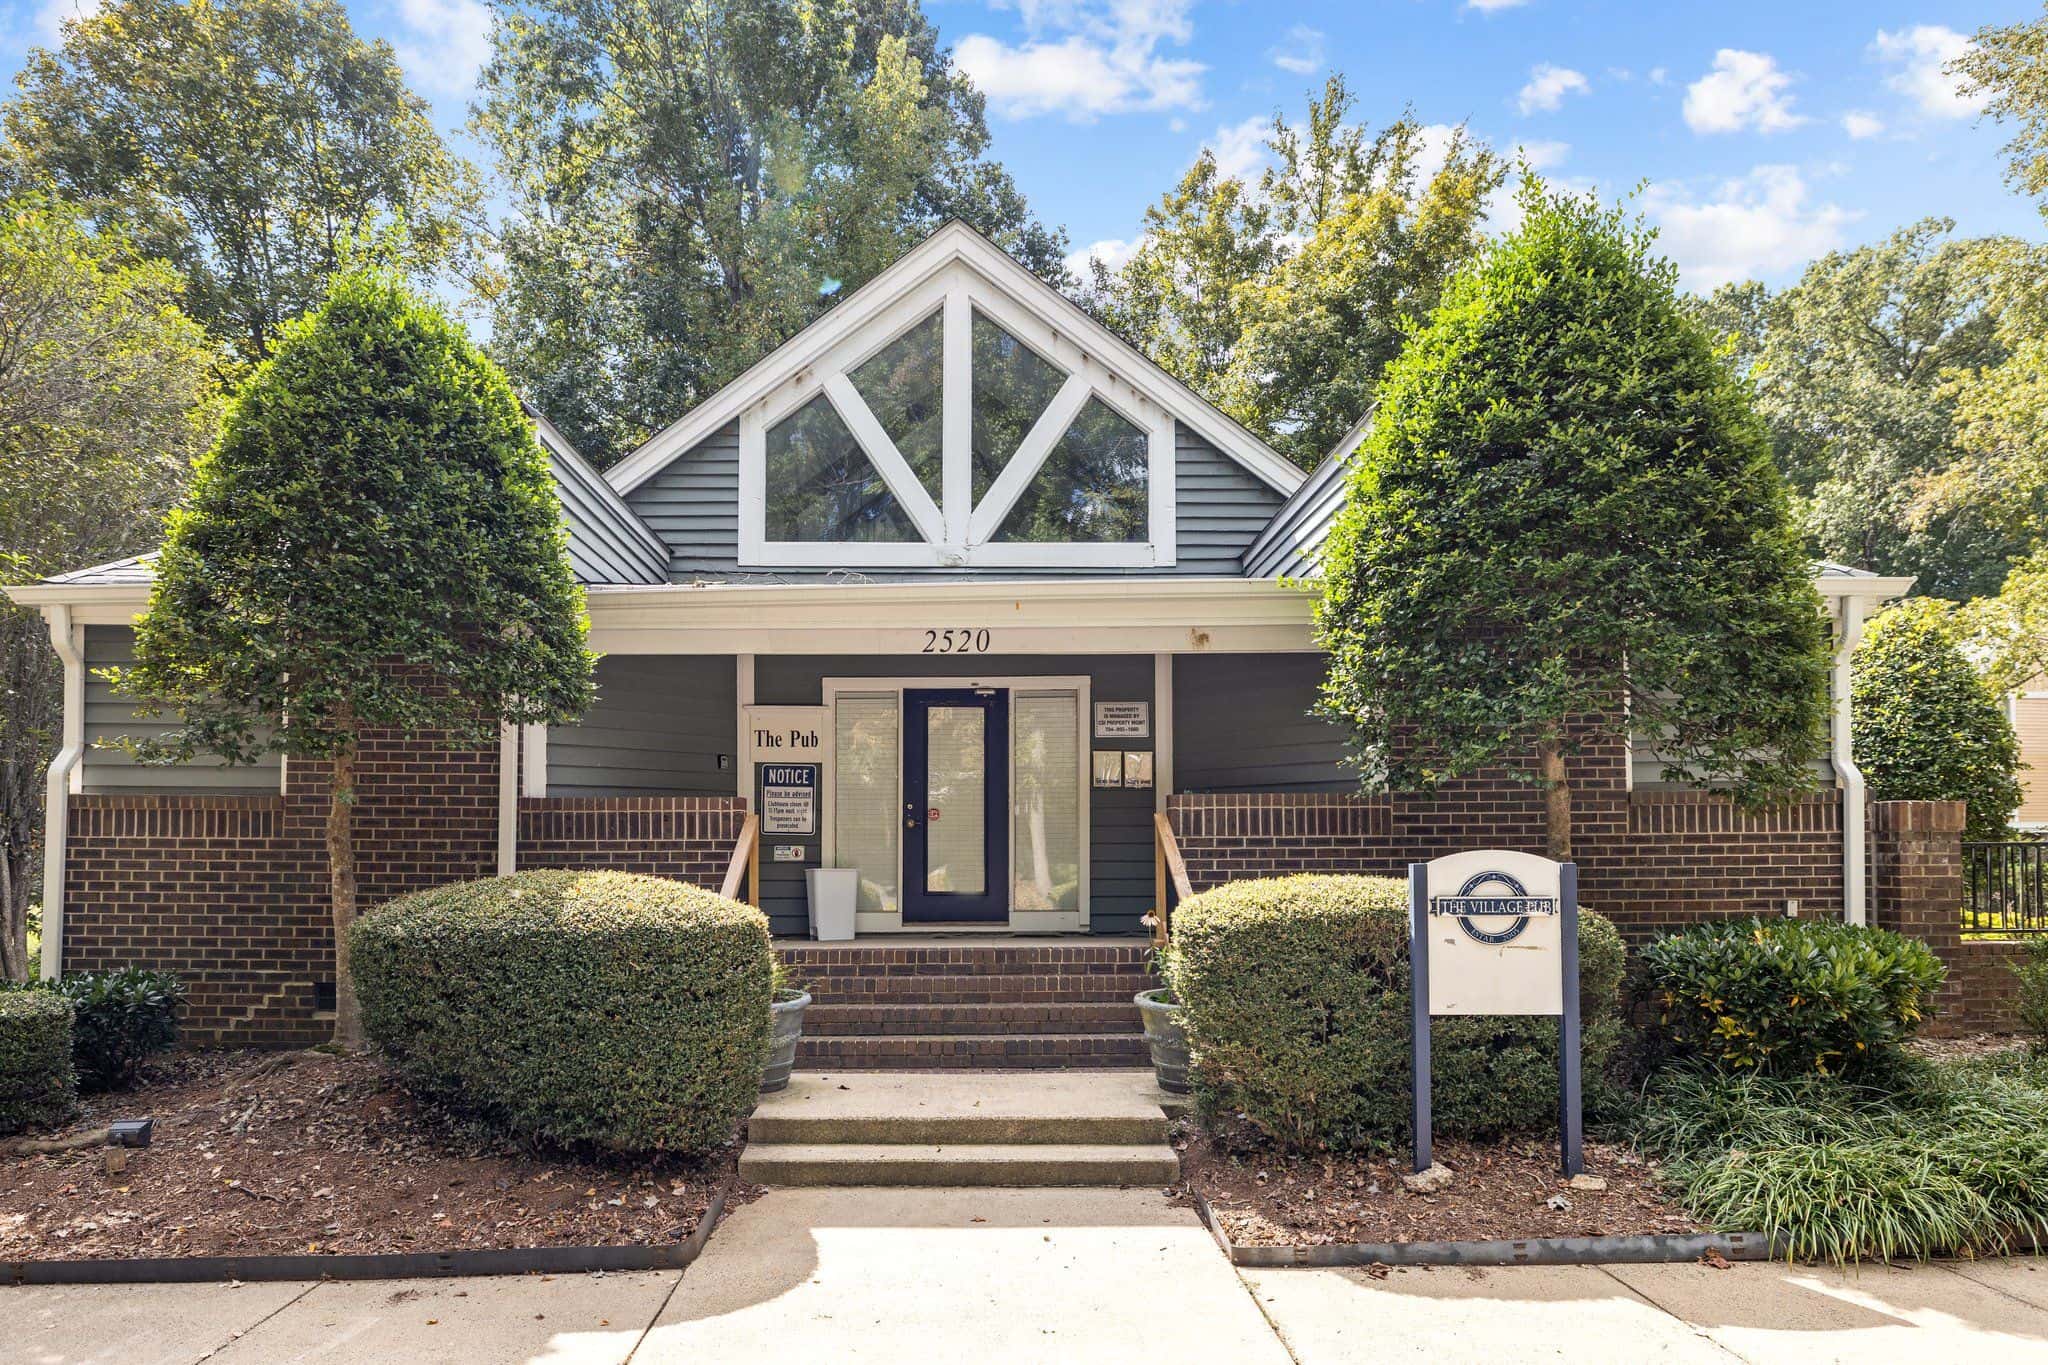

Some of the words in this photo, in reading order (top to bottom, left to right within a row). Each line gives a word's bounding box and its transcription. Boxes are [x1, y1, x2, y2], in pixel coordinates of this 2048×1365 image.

[922, 629, 990, 652] 2520
[754, 729, 782, 748] The
[790, 730, 818, 748] Pub
[769, 769, 809, 784] NOTICE
[767, 790, 782, 798] Please
[792, 790, 811, 798] advised
[1440, 901, 1467, 913] THE
[1470, 901, 1523, 913] VILLAGE
[1526, 900, 1553, 913] PUB
